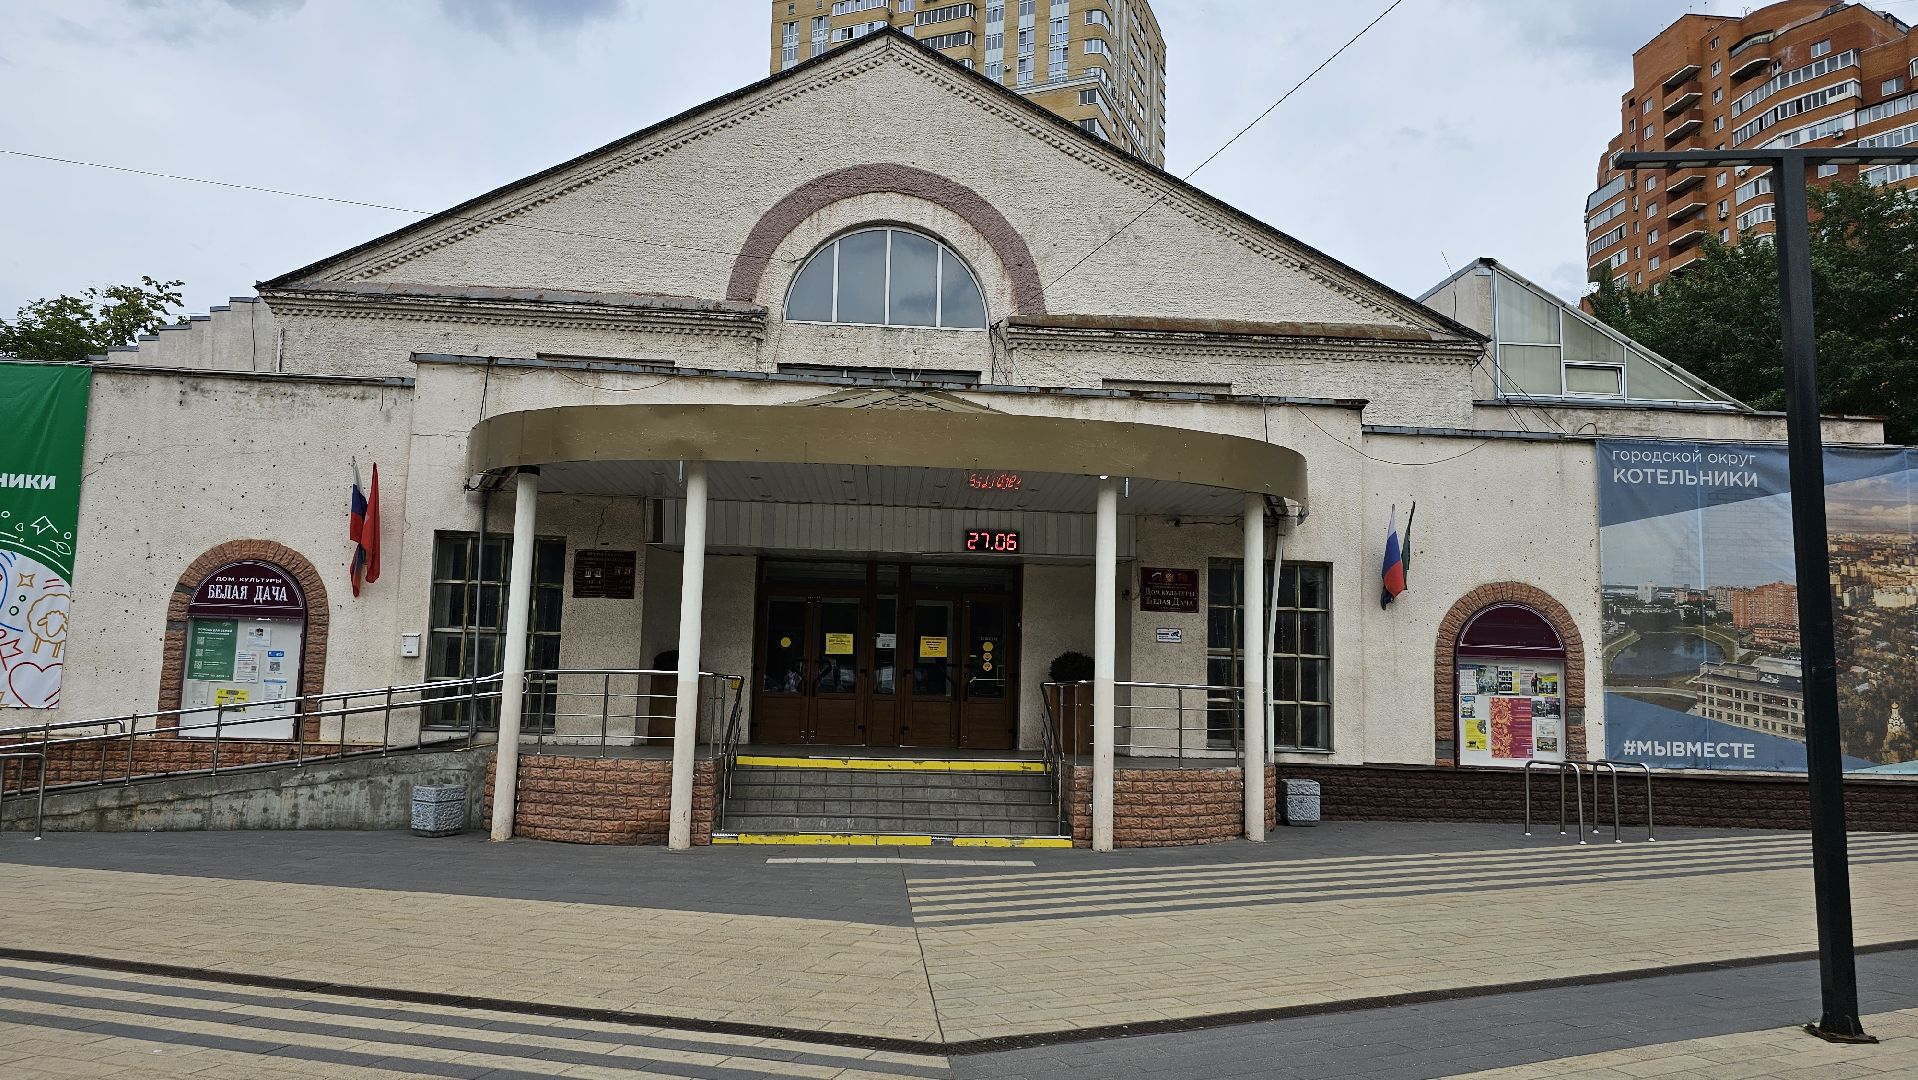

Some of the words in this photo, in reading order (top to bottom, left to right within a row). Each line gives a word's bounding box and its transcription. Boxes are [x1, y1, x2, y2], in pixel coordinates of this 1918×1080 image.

[1612, 449, 1702, 464] городской
[1707, 453, 1756, 467] округ
[1613, 467, 1758, 488] КОТЕЛЬНИКИ
[967, 532, 1017, 551] 27.06
[207, 584, 249, 600] БЕЛАЯ
[253, 585, 289, 604] ДАЧА
[1623, 739, 1756, 759] #МЫВМЕСТЕ
